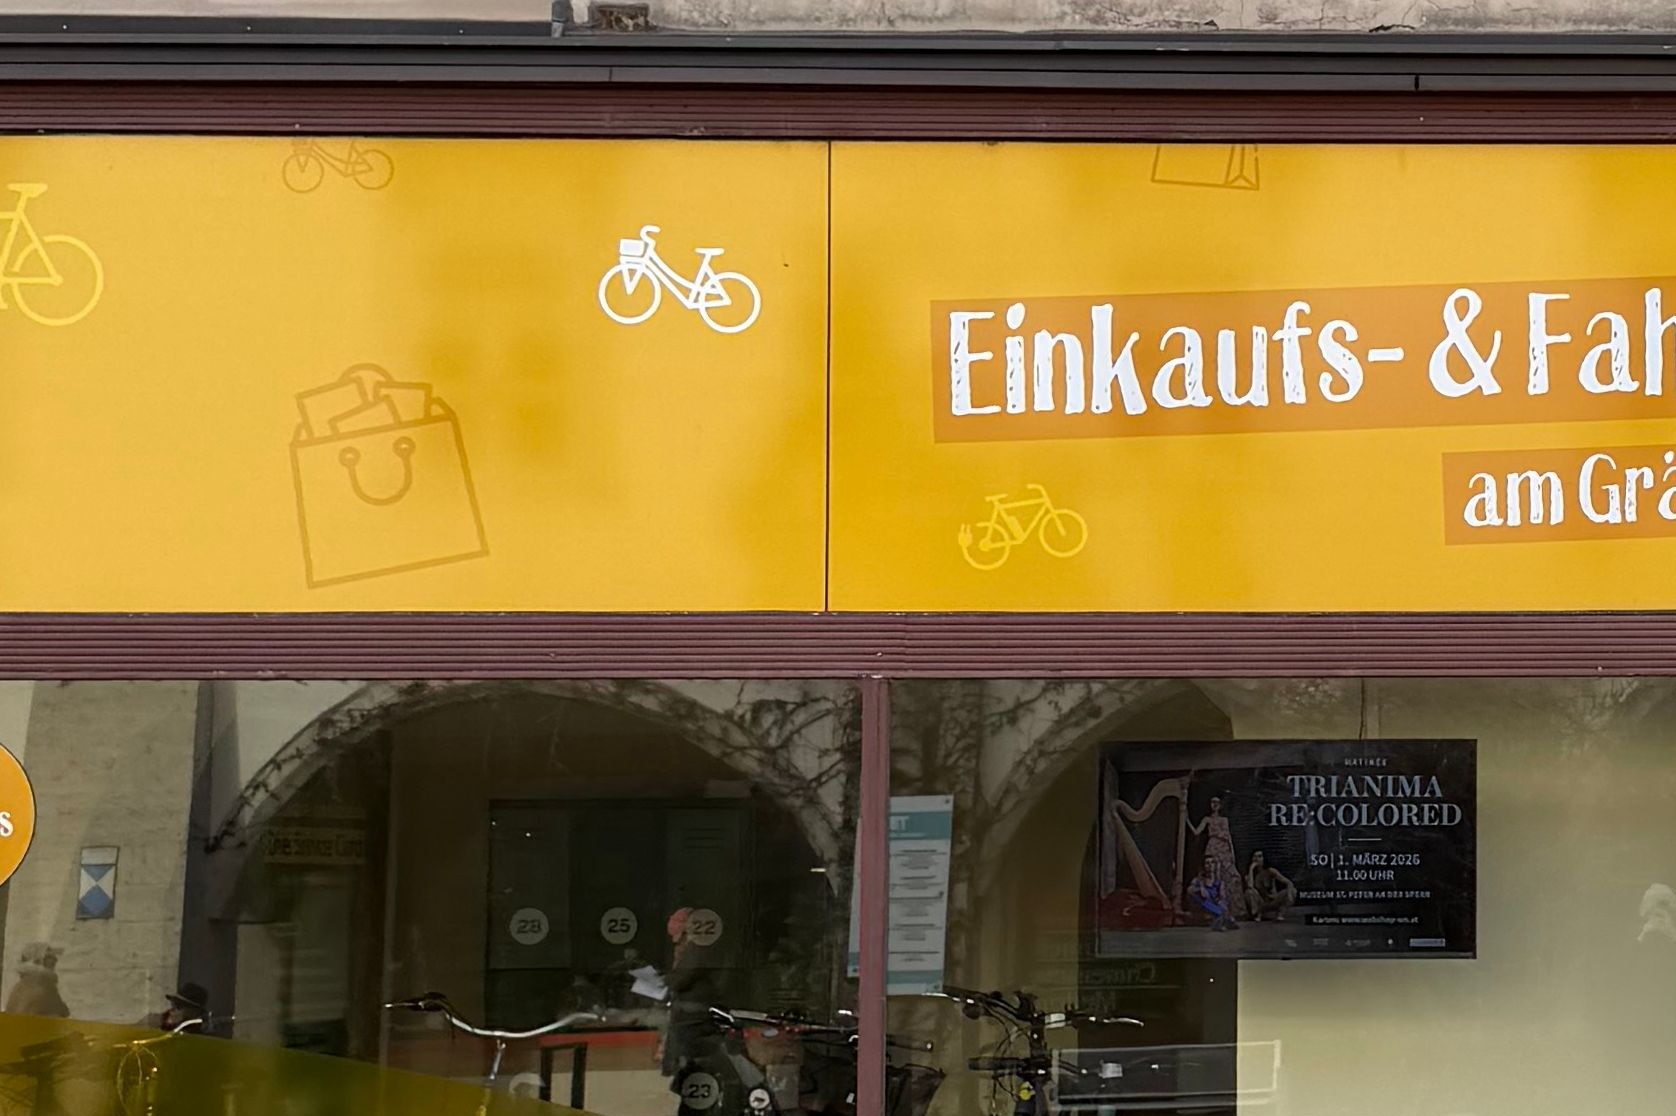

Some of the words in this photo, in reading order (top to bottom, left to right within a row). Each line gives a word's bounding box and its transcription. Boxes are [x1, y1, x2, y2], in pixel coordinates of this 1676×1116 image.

[949, 300, 1404, 417] Einkaufs-
[1427, 288, 1502, 399] &
[1463, 470, 1565, 528] am
[1286, 775, 1442, 798] TRIANIMA
[1268, 803, 1462, 826] RE:COLORED
[1310, 854, 1328, 866] SO
[1352, 852, 1387, 866] MÄRZ
[1390, 854, 1420, 866] 2026
[1336, 870, 1367, 881] 11.00
[1369, 870, 1394, 881] UHR
[607, 918, 631, 933] 25
[691, 920, 716, 935] 22
[688, 1083, 711, 1098] 23
